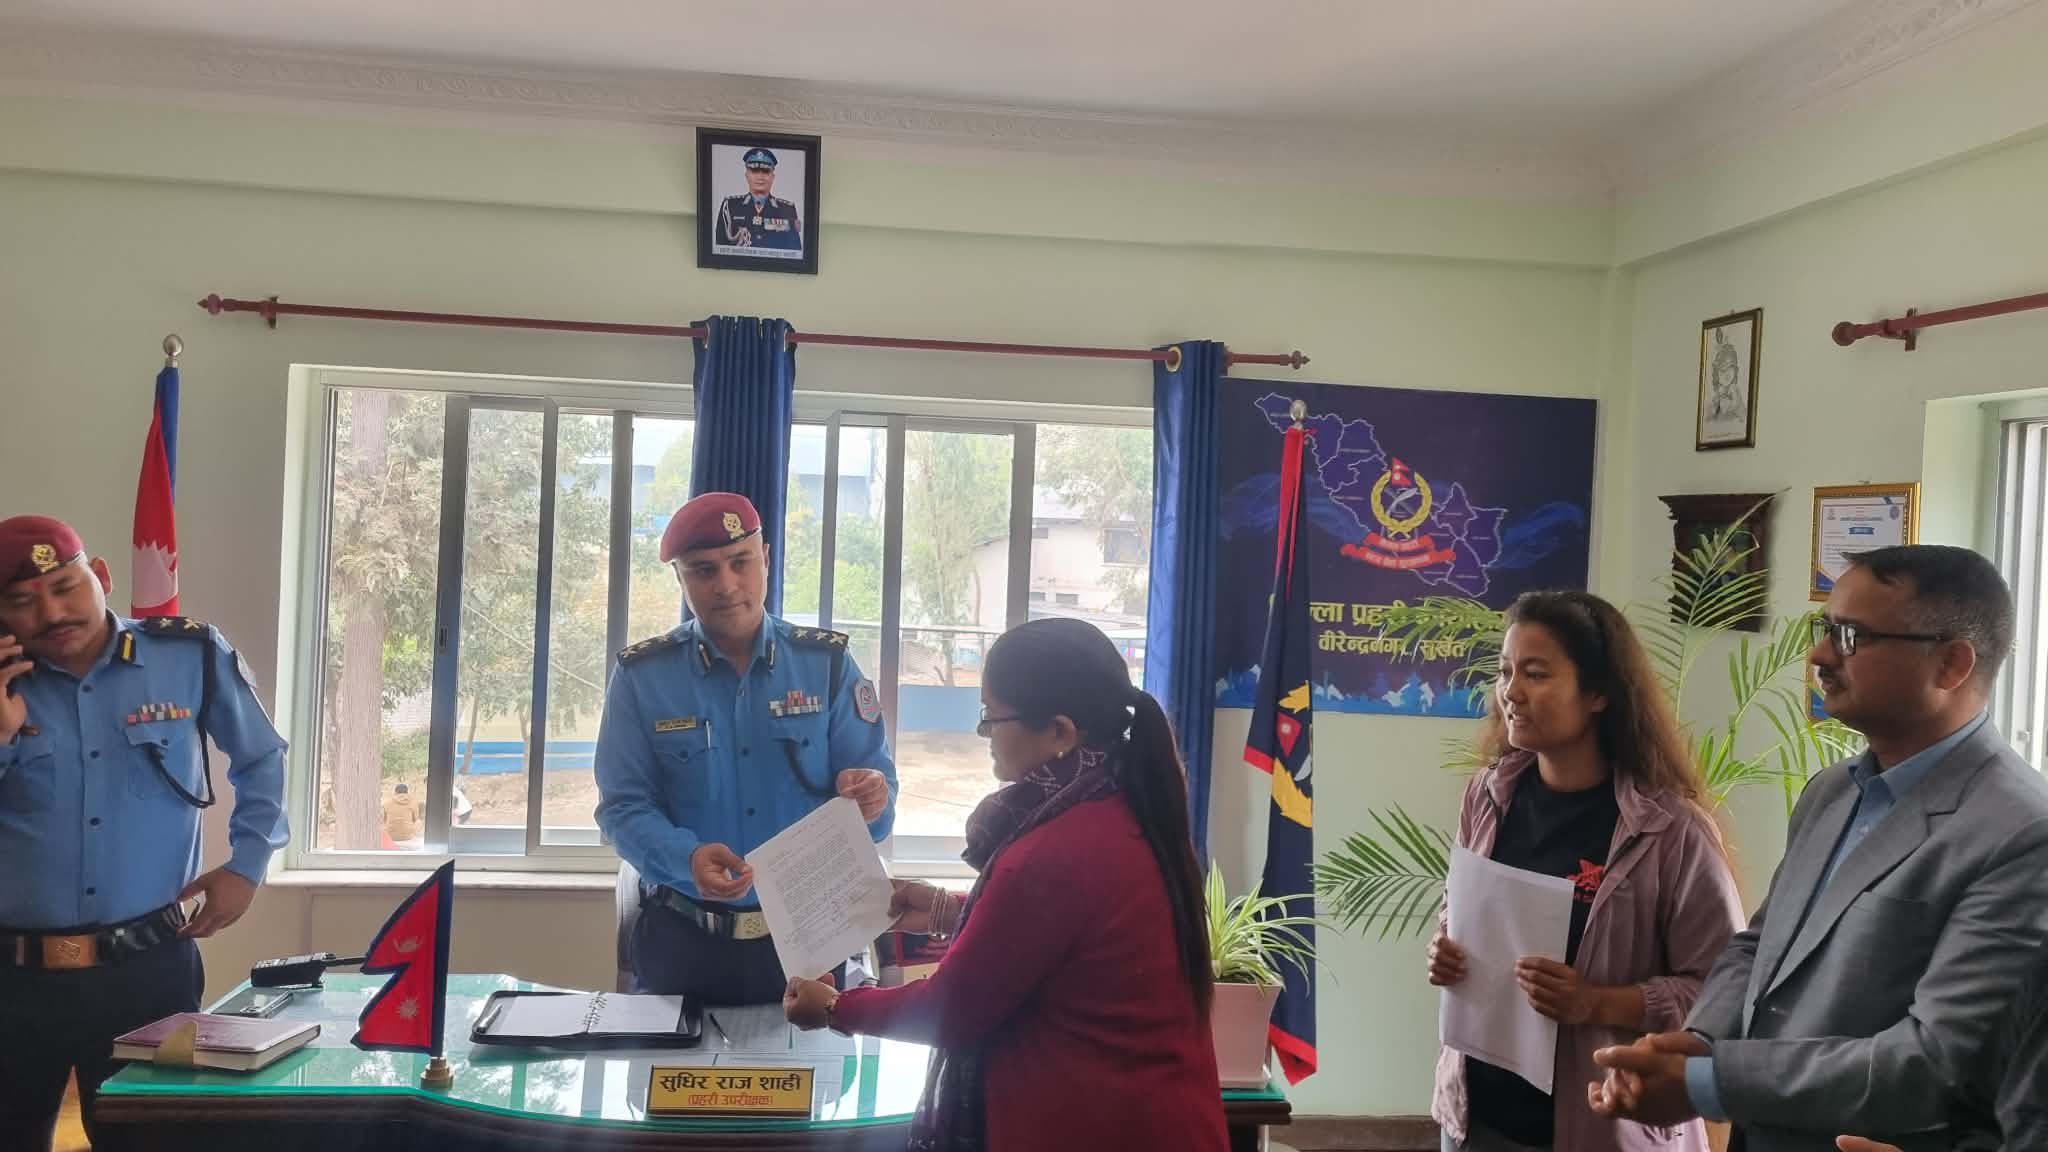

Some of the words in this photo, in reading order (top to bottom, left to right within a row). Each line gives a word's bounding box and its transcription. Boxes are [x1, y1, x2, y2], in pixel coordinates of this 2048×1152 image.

[659, 1071, 711, 1092] सुधिर
[716, 1075, 753, 1090] राज
[759, 1073, 801, 1091] शाही
